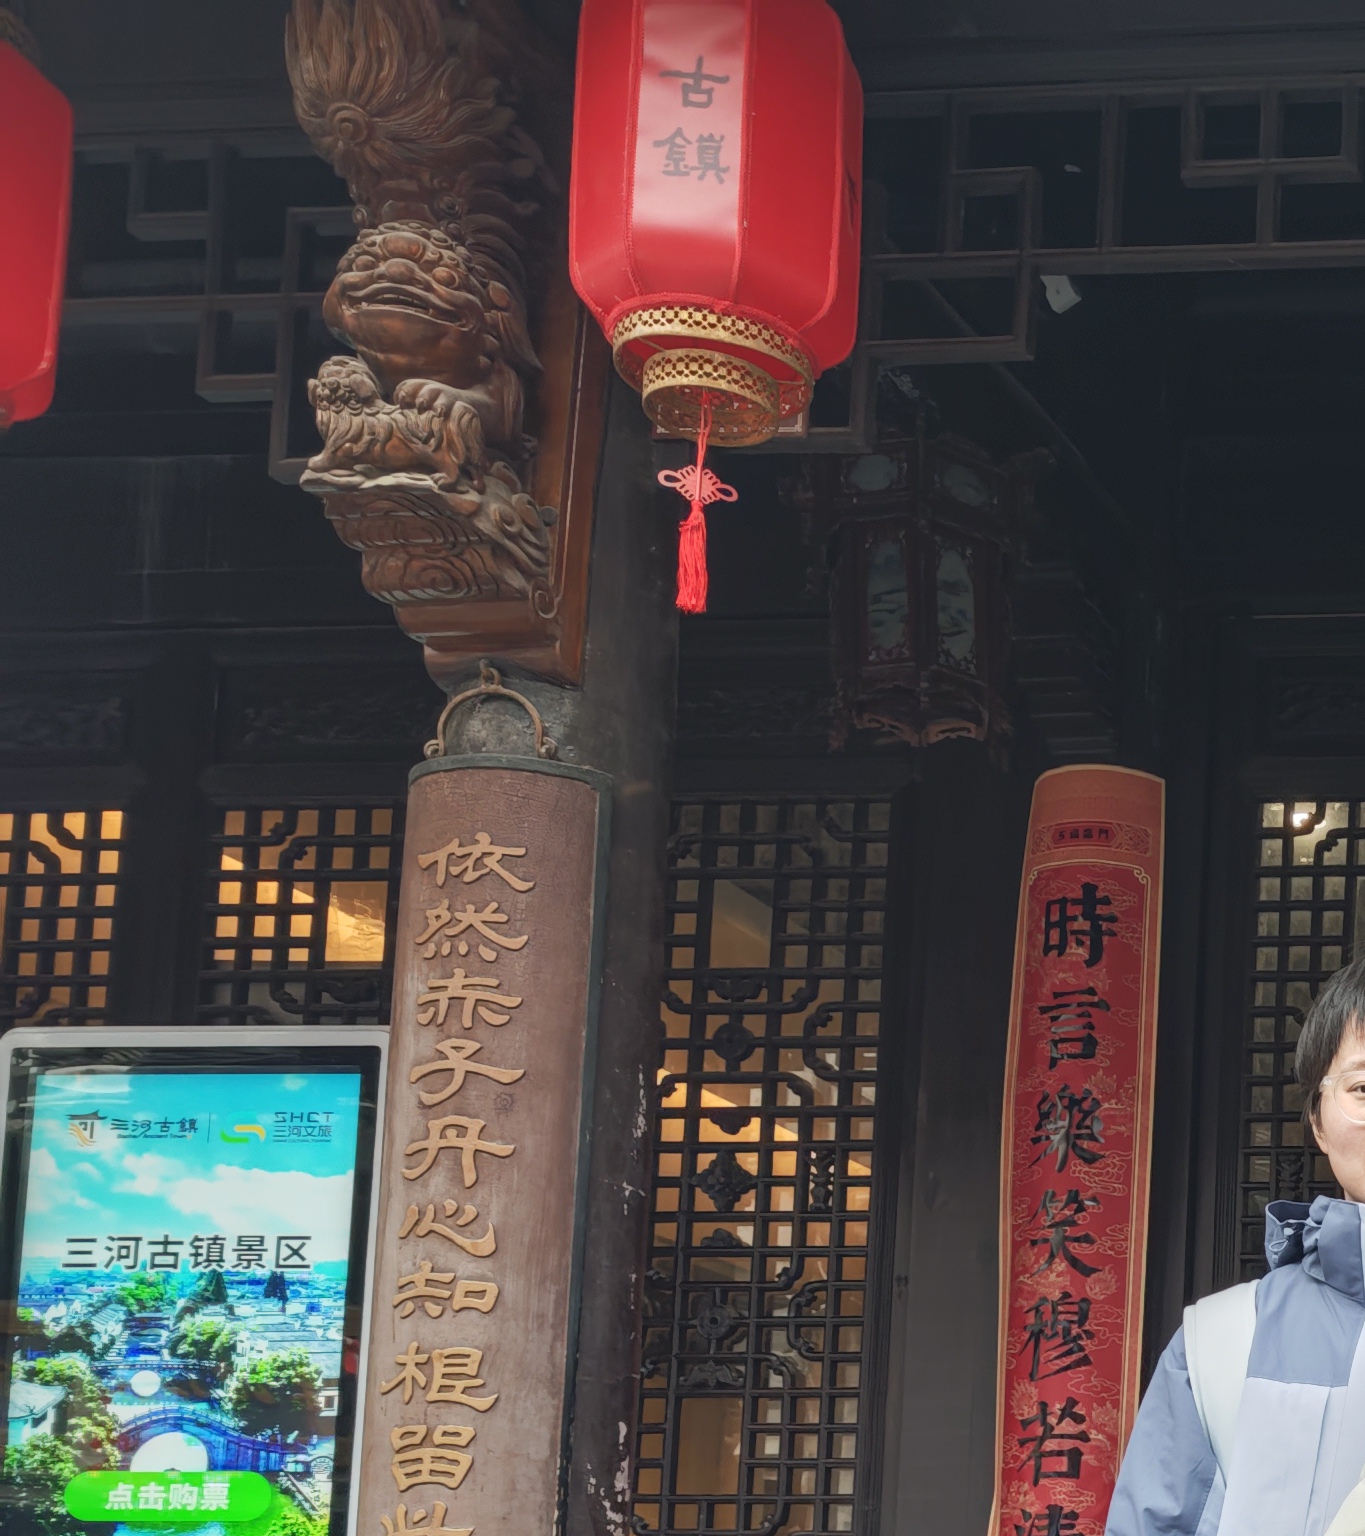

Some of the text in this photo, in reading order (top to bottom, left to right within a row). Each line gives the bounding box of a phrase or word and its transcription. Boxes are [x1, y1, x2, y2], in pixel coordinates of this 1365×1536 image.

[652, 55, 730, 185] 古鎮
[272, 1124, 333, 1137] 三河文旅
[273, 1111, 335, 1123] SHCT
[62, 1233, 312, 1270] 三河古镇景区
[104, 1482, 231, 1511] 点击购票
